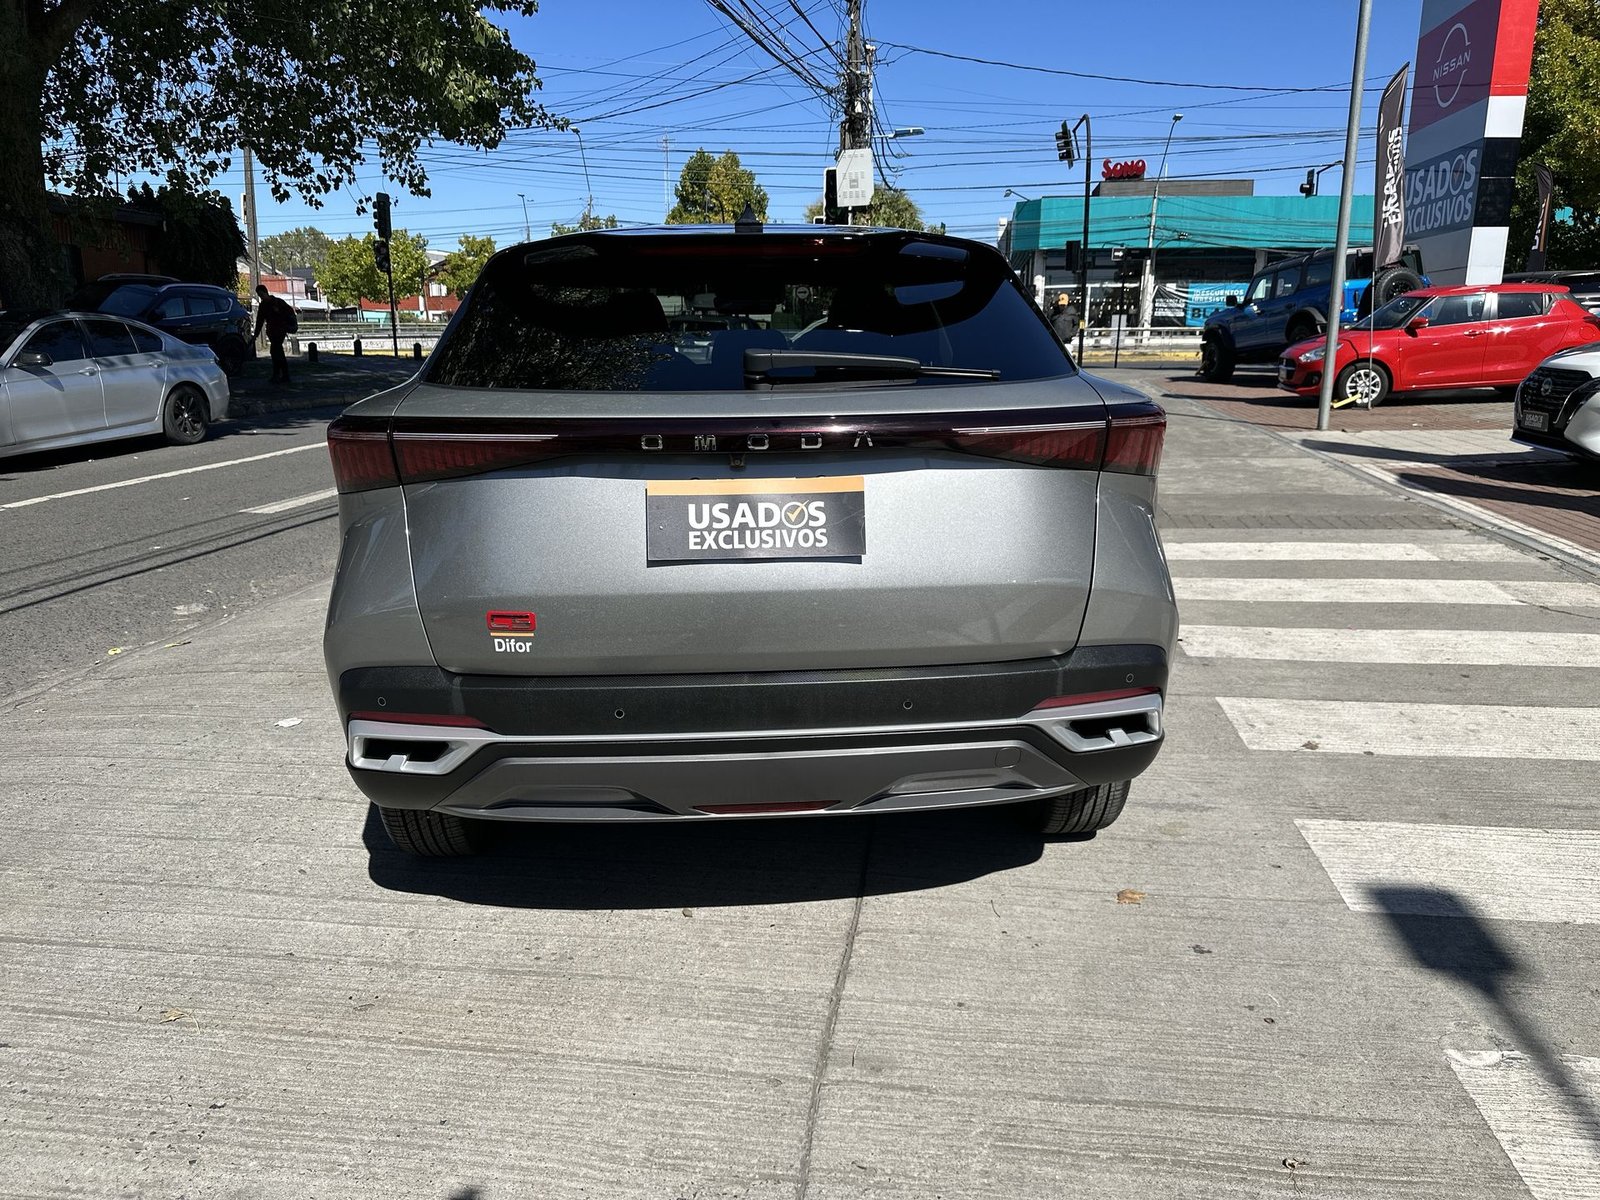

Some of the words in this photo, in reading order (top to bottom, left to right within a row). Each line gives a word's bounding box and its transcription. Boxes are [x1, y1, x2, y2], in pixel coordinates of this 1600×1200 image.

[1433, 50, 1471, 81] NISSAN
[1405, 191, 1473, 235] XCLUSIVOS
[641, 430, 873, 450] OMODA
[688, 500, 826, 529] USADOS
[688, 528, 828, 550] EXCLUSIVOS
[494, 638, 532, 653] Difor
